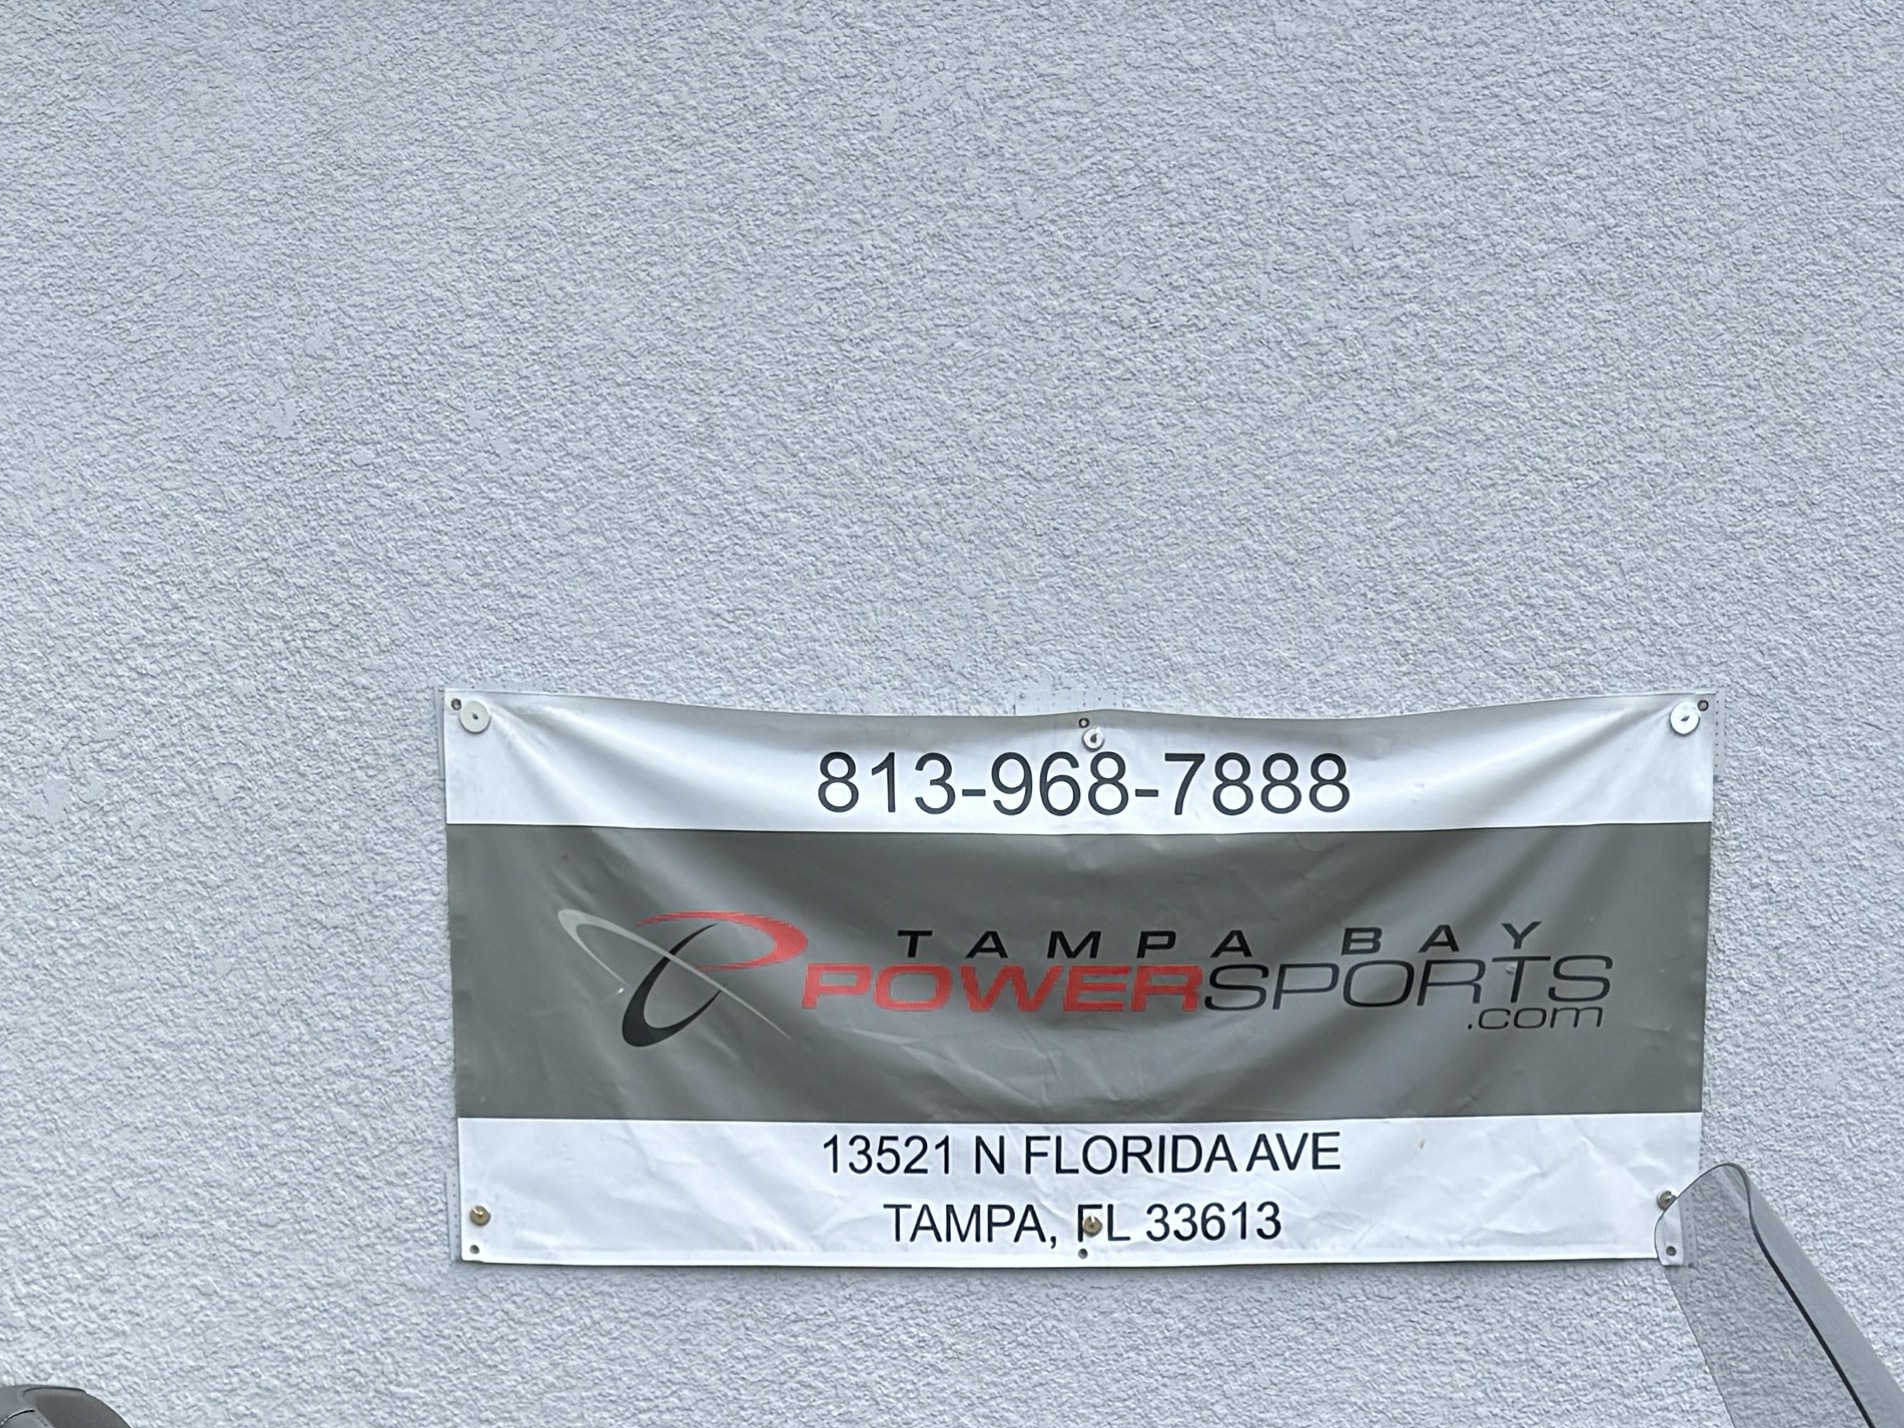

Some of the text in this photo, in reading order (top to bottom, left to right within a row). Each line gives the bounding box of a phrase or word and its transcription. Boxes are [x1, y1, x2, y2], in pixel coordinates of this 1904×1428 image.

[817, 750, 1351, 817] 813-968-7888
[897, 921, 1541, 960] TAMPA BAY
[800, 954, 1614, 1012] POWERSPORTS
[1466, 1006, 1604, 1031] .com
[822, 1130, 1342, 1176] 13521 N FLORIDA AVE
[882, 1200, 1283, 1250] TAMPA, FL 33613
